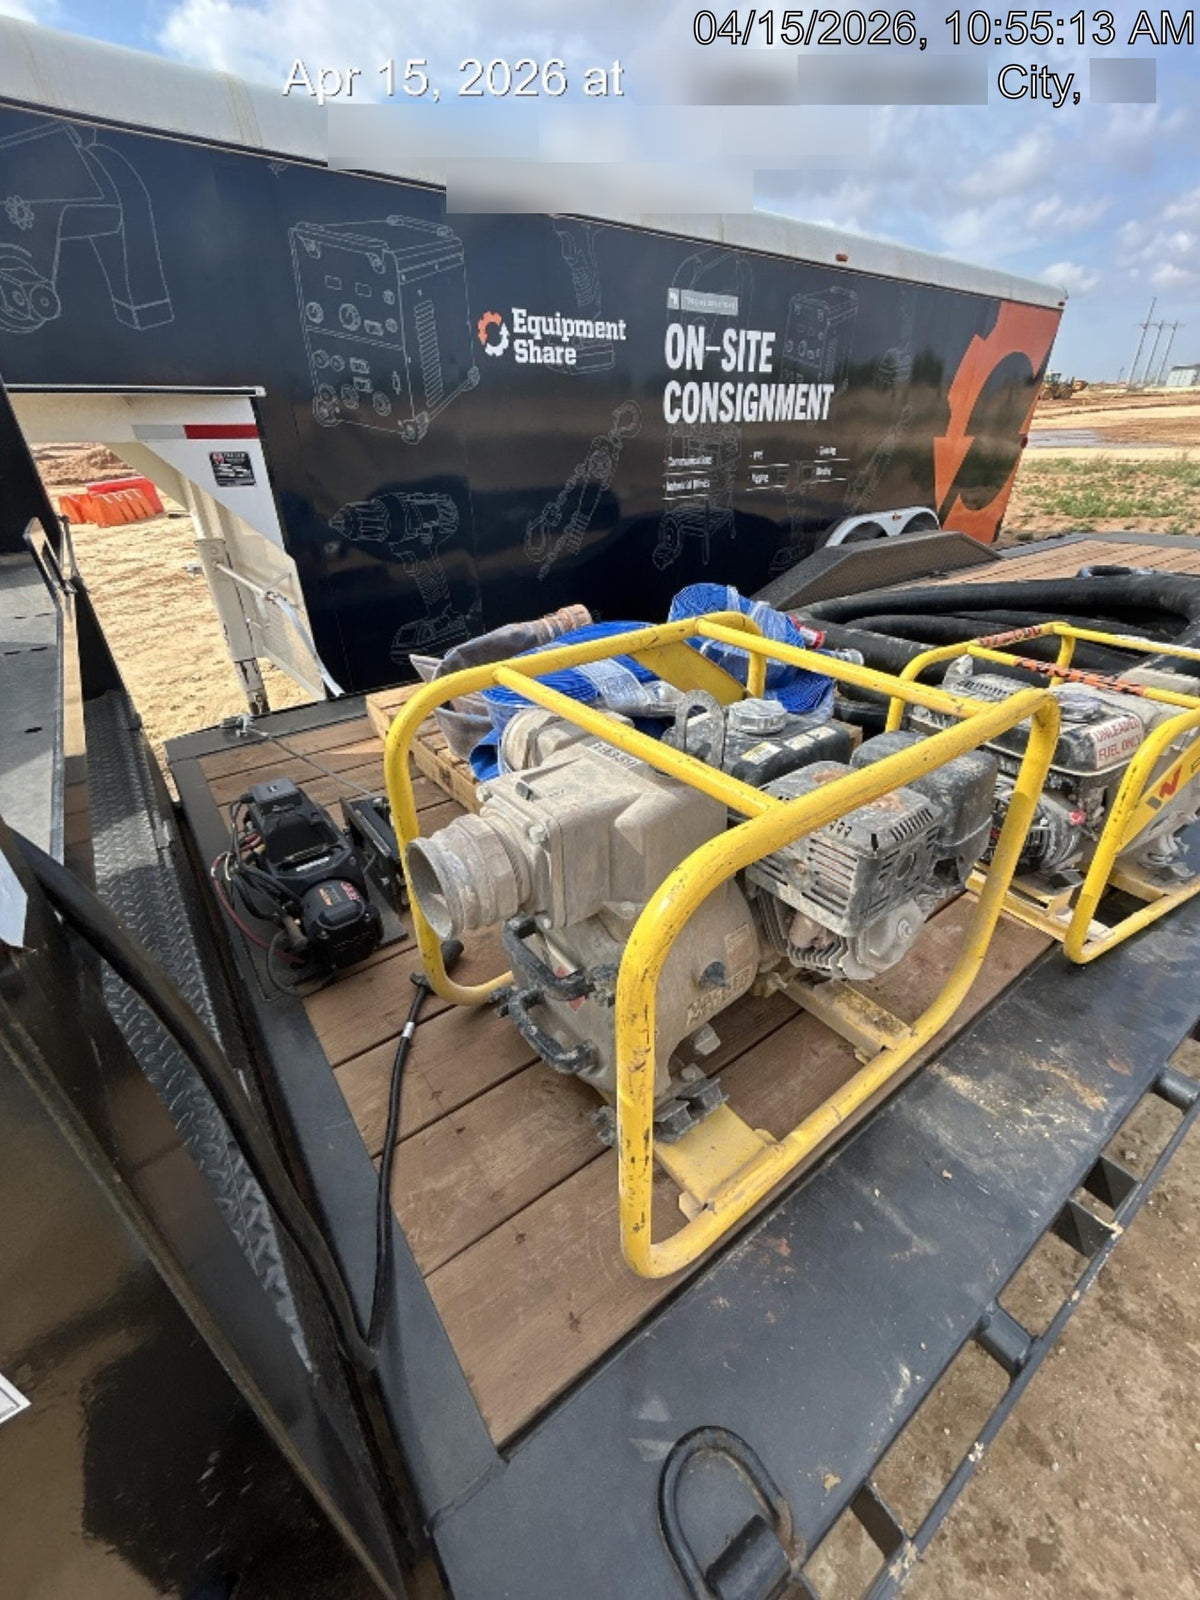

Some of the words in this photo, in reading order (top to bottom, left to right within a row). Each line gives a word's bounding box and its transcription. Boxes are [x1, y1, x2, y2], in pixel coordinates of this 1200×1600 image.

[511, 307, 627, 342] Equipment
[514, 339, 577, 366] Share
[665, 323, 776, 372] ON-SITE
[664, 380, 834, 424] CONSIGNMENT
[1095, 716, 1139, 743] UNLEADED
[1097, 743, 1121, 760] FUEL
